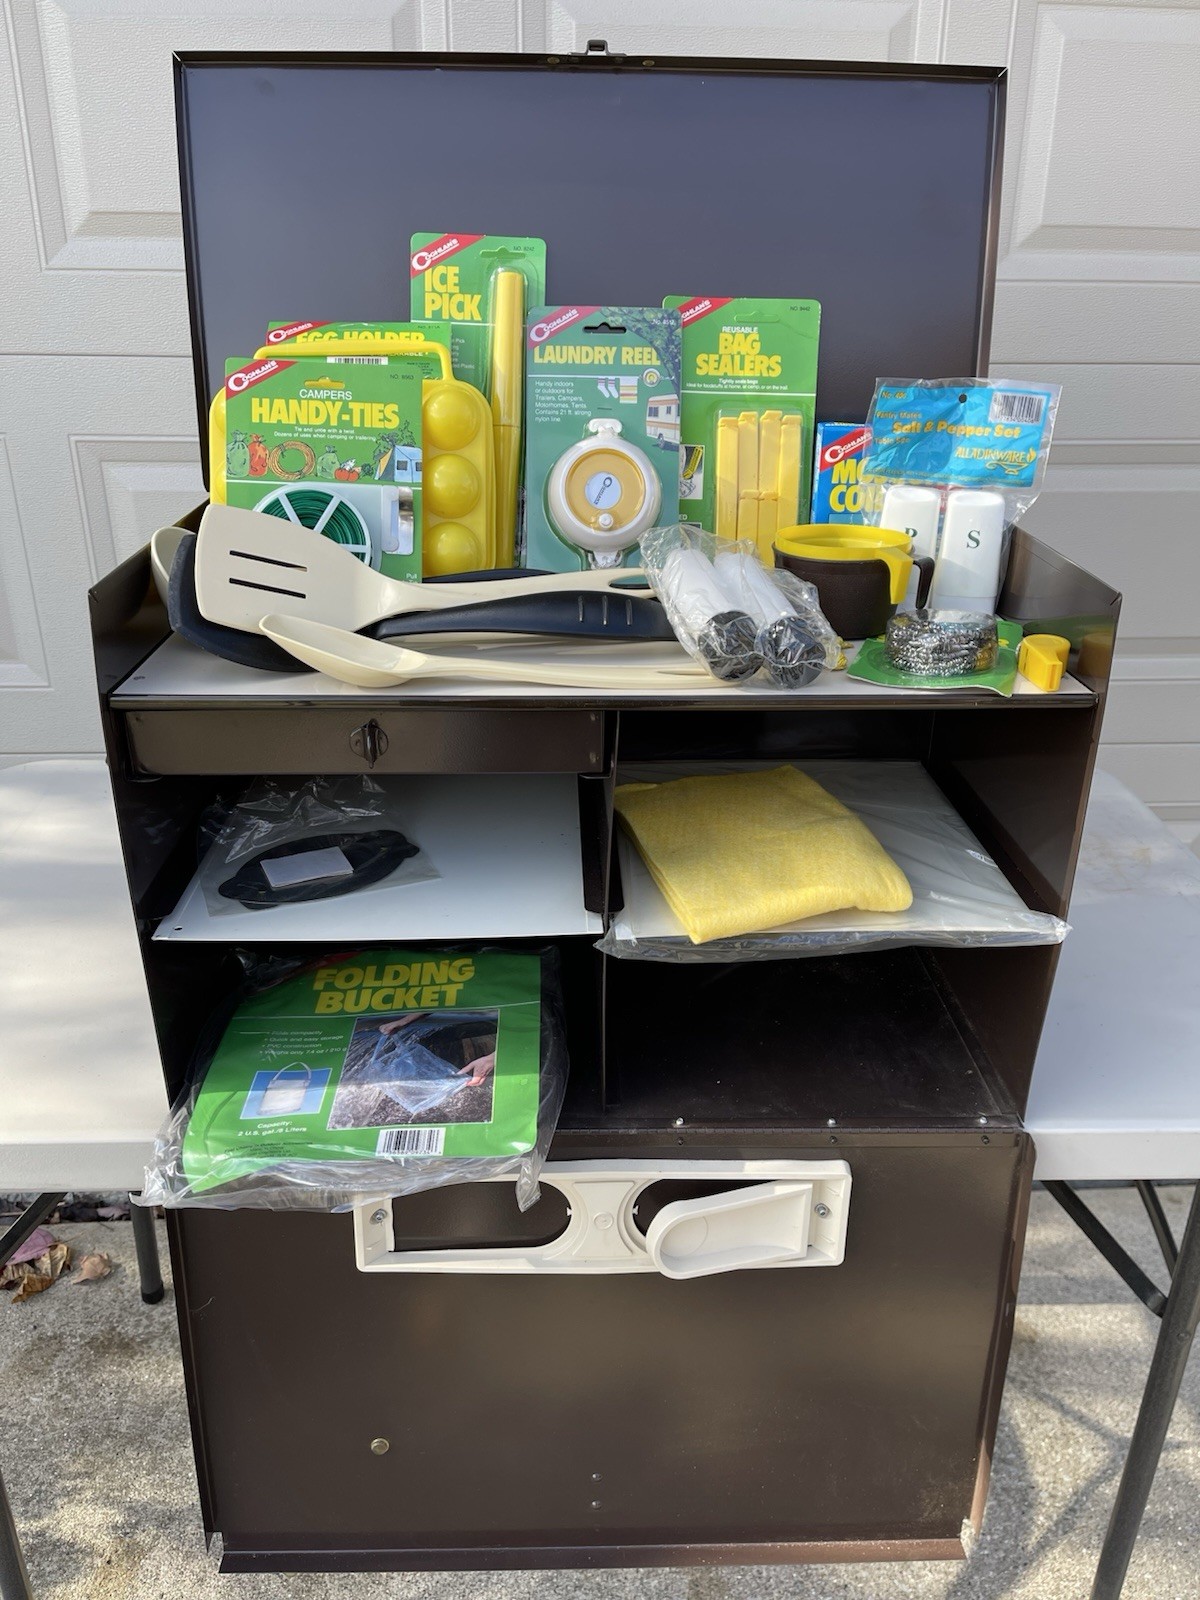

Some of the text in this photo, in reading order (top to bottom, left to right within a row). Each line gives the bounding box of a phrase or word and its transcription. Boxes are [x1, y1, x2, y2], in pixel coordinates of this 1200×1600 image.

[412, 238, 460, 270] COGHLAN'S
[424, 266, 460, 292] ICE
[424, 292, 482, 320] PICK
[530, 308, 578, 342] COGHLAN'S
[534, 346, 661, 366] LAUNDRY REEL
[718, 332, 760, 355] BAG
[228, 360, 278, 392] COGHLAN'S
[696, 354, 782, 378] SEALERS
[300, 389, 352, 400] CAMPERS
[252, 397, 400, 430] HANDY-TIES
[892, 420, 921, 434] Salt
[924, 420, 934, 432] &
[936, 420, 990, 438] Pepper
[993, 424, 1022, 438] Set
[966, 530, 980, 549] S
[312, 958, 476, 991] FOLDING
[314, 984, 464, 1014] BUCKET
